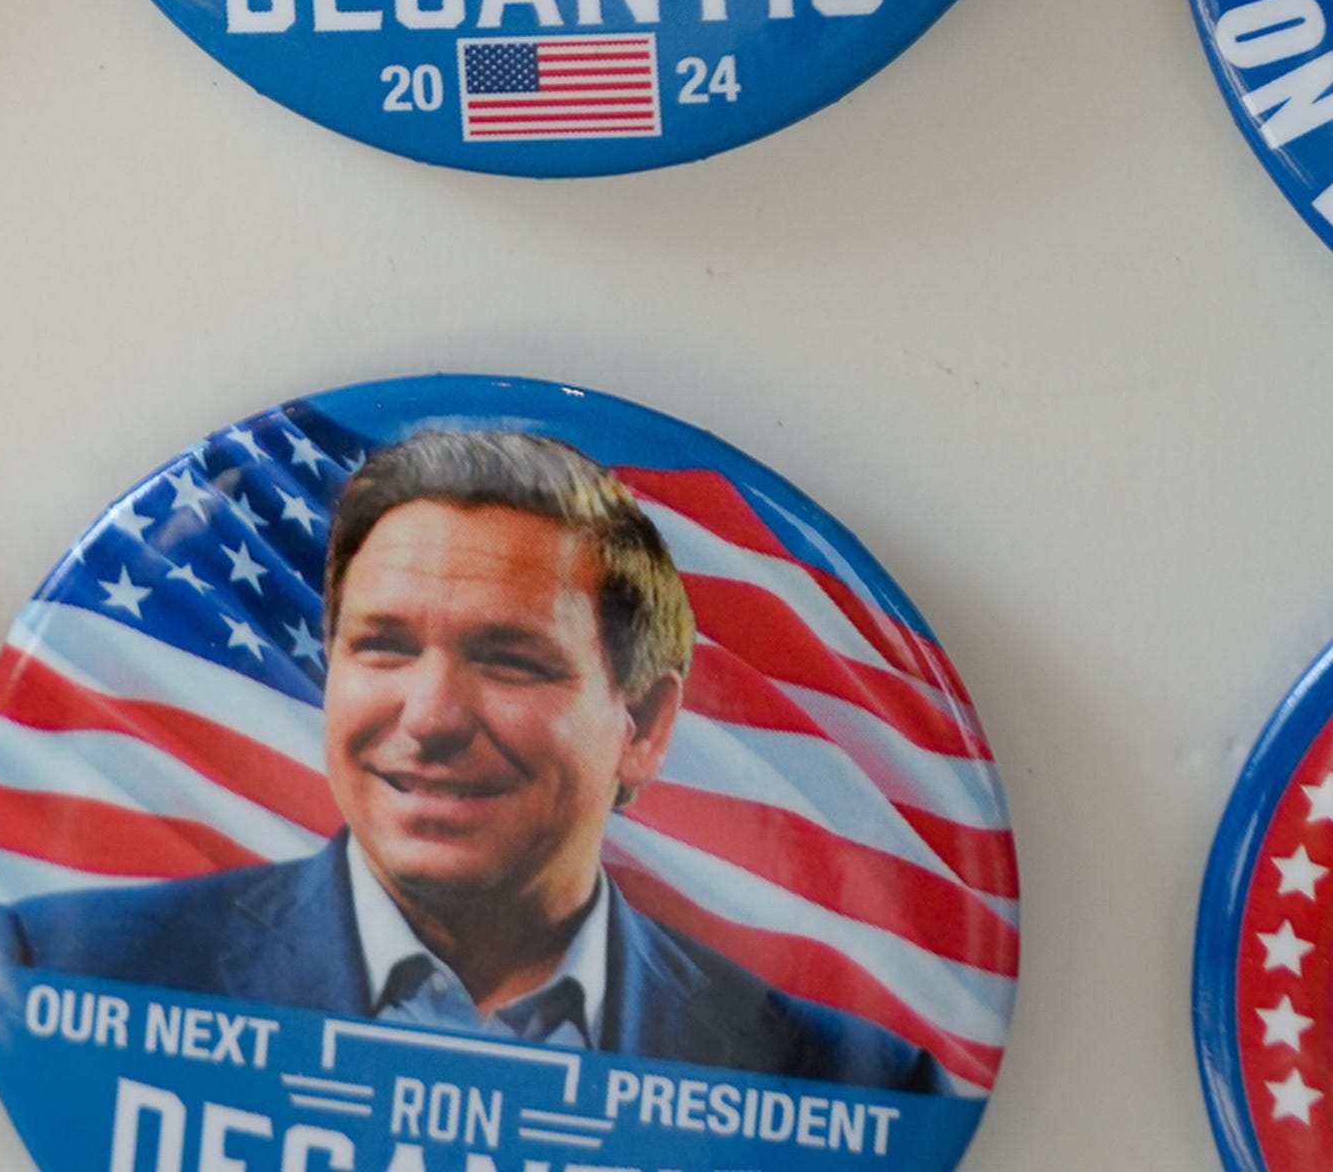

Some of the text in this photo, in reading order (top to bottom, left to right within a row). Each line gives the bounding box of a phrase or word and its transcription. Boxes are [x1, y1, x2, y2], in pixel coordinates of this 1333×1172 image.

[381, 55, 742, 112] 20 24
[25, 984, 280, 1070] OUR NEXT
[390, 1076, 504, 1149] RON
[604, 1066, 901, 1158] PRESIDENT
